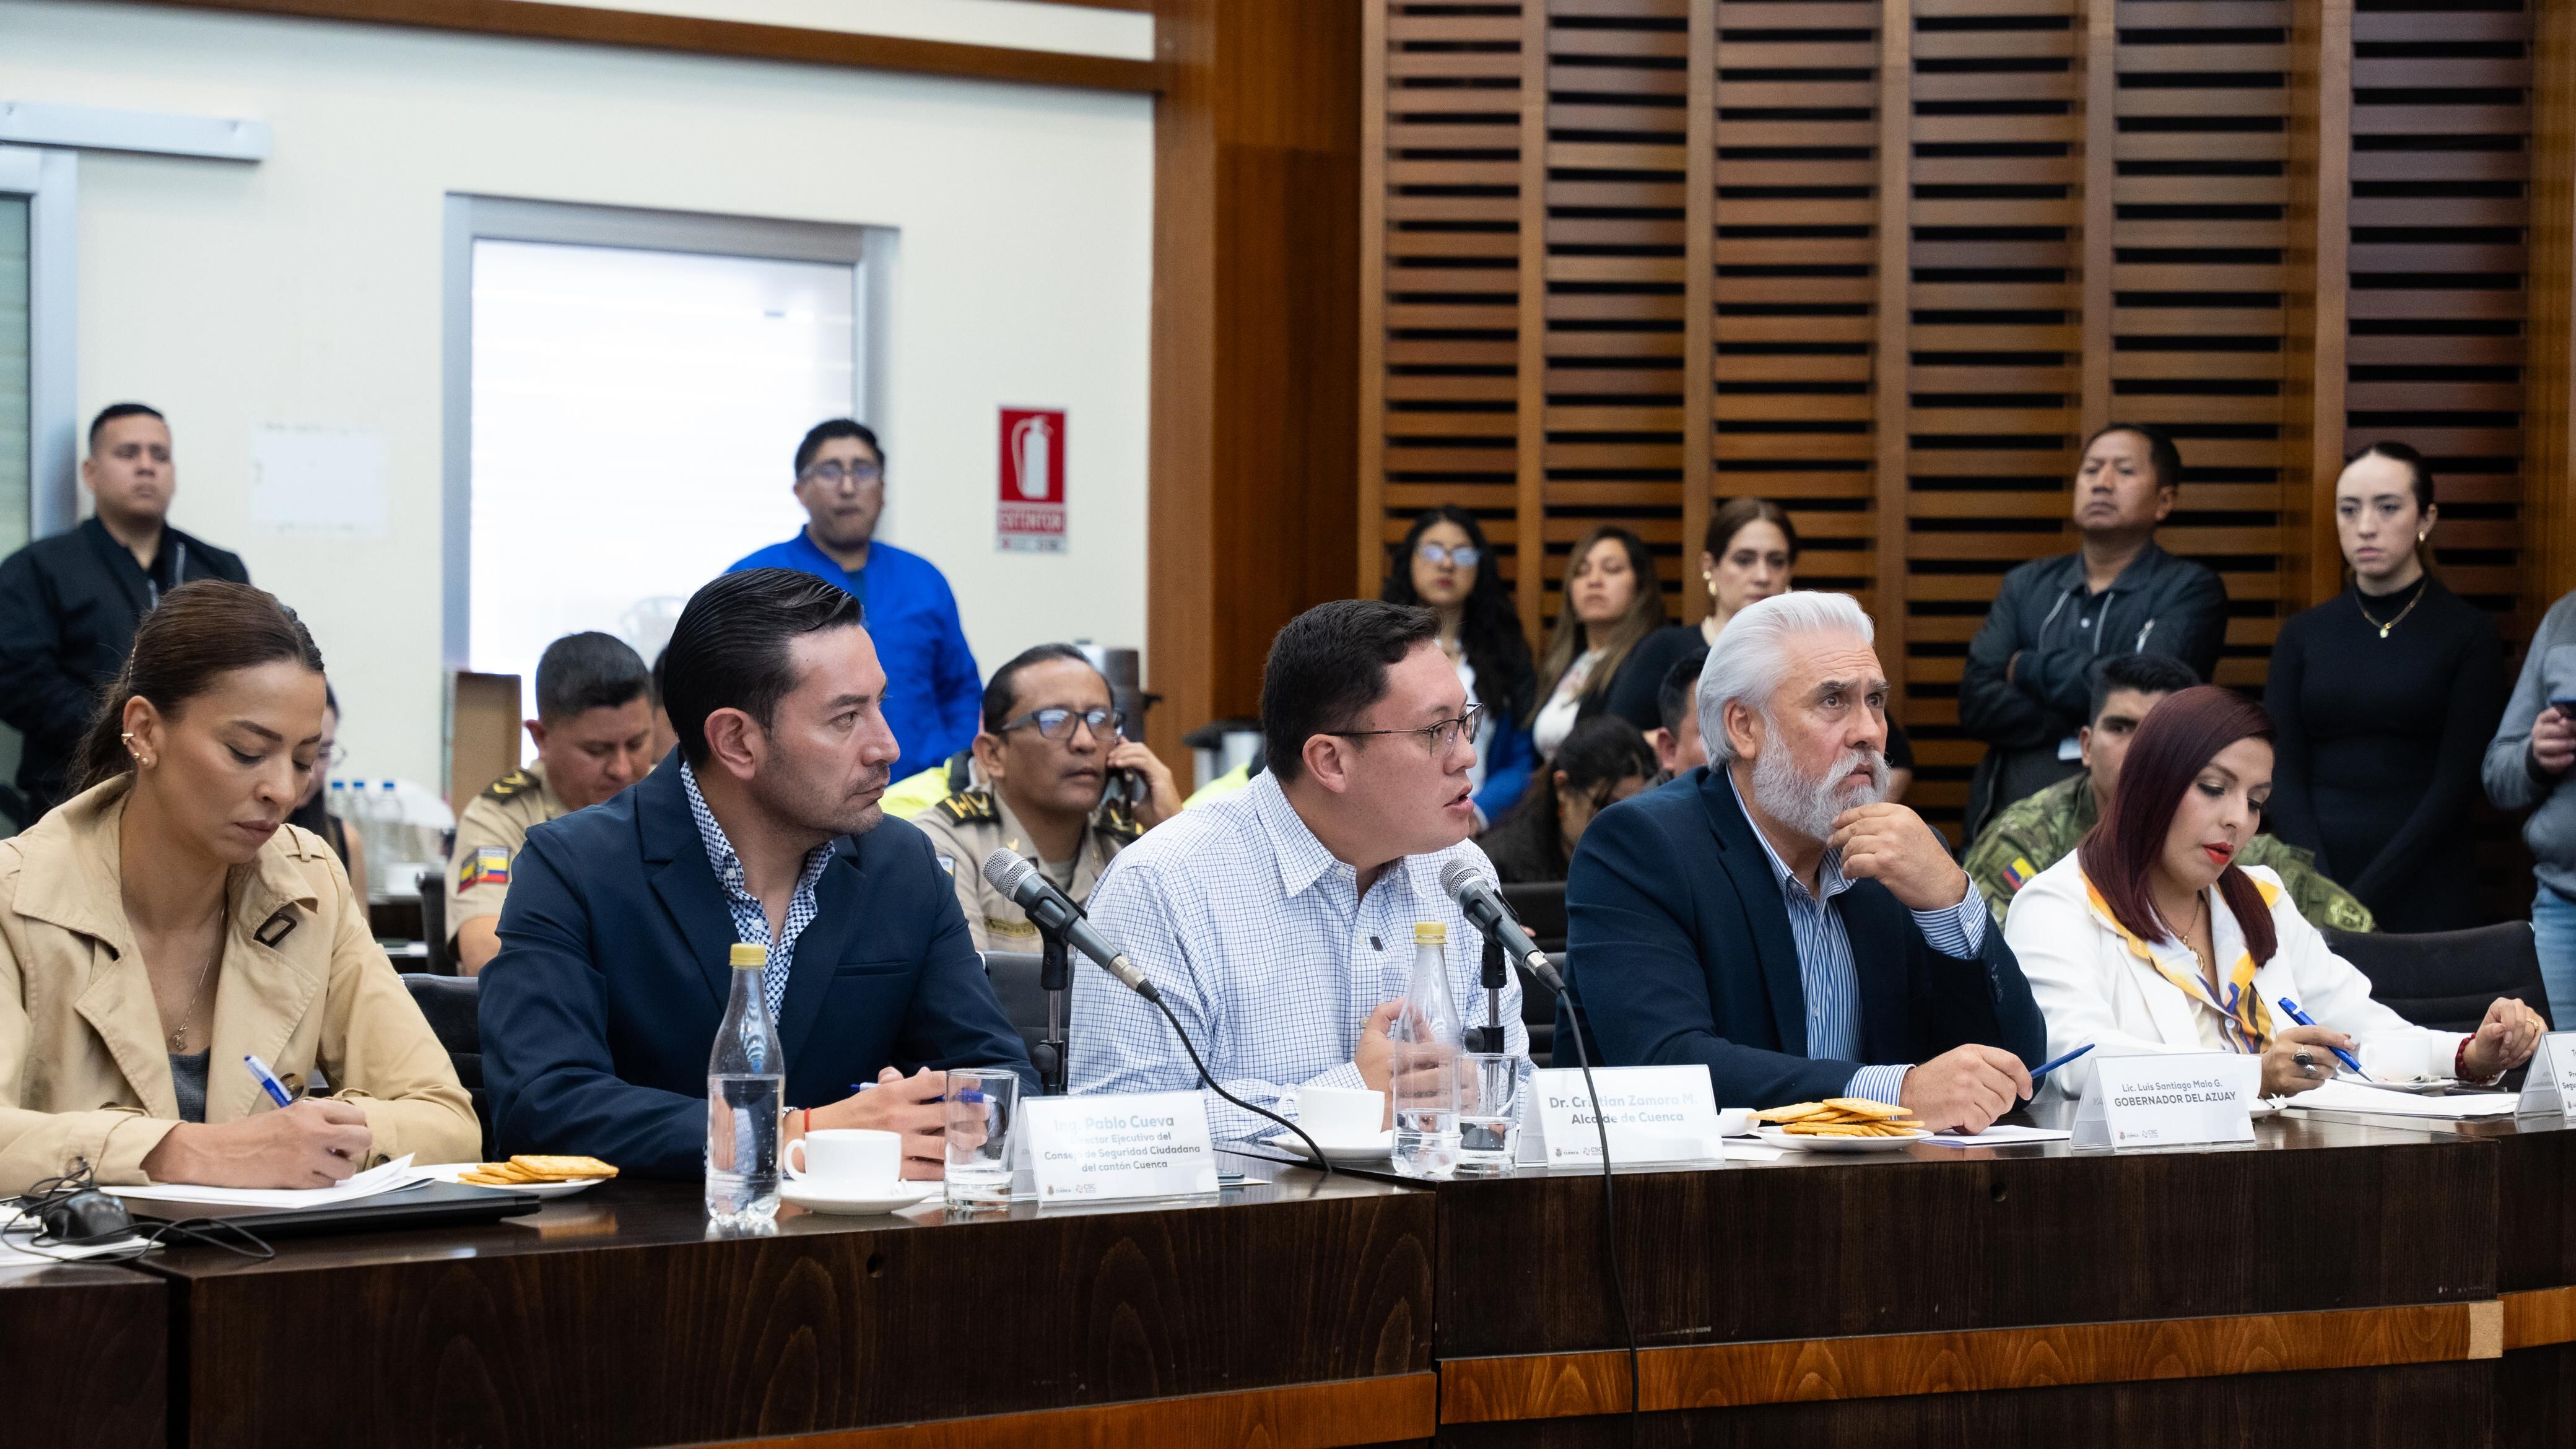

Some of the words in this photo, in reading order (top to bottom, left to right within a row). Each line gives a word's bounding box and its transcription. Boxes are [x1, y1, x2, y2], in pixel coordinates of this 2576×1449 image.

[2122, 1084, 2136, 1092] Lic.
[2138, 1083, 2154, 1091] Luis
[2156, 1081, 2191, 1092] Santiago
[2193, 1080, 2213, 1088] Malo
[2214, 1079, 2222, 1087] G.
[1549, 1097, 1569, 1108] Dr.
[1572, 1095, 1625, 1108] Critian
[1627, 1094, 1679, 1107] Zamora
[1682, 1092, 1699, 1105] M.
[2115, 1094, 2183, 1107] GOBERNADOR
[2185, 1093, 2204, 1103] DEL
[2206, 1091, 2235, 1102] AZUAY
[1085, 1116, 1126, 1129] Pablo
[1130, 1115, 1175, 1128] Cueva
[1572, 1113, 1617, 1124] Alcade
[1621, 1112, 1635, 1123] de
[1638, 1112, 1684, 1123] Cuenca
[1112, 1133, 1155, 1145] Ejecutivo
[1157, 1131, 1172, 1141] del
[1084, 1150, 1097, 1158] de
[1099, 1147, 1147, 1160] Seguridad
[1150, 1145, 1200, 1155] Ciudadana
[1082, 1163, 1096, 1172] del
[1099, 1162, 1131, 1171] cantón
[1133, 1160, 1168, 1169] Cuenca
